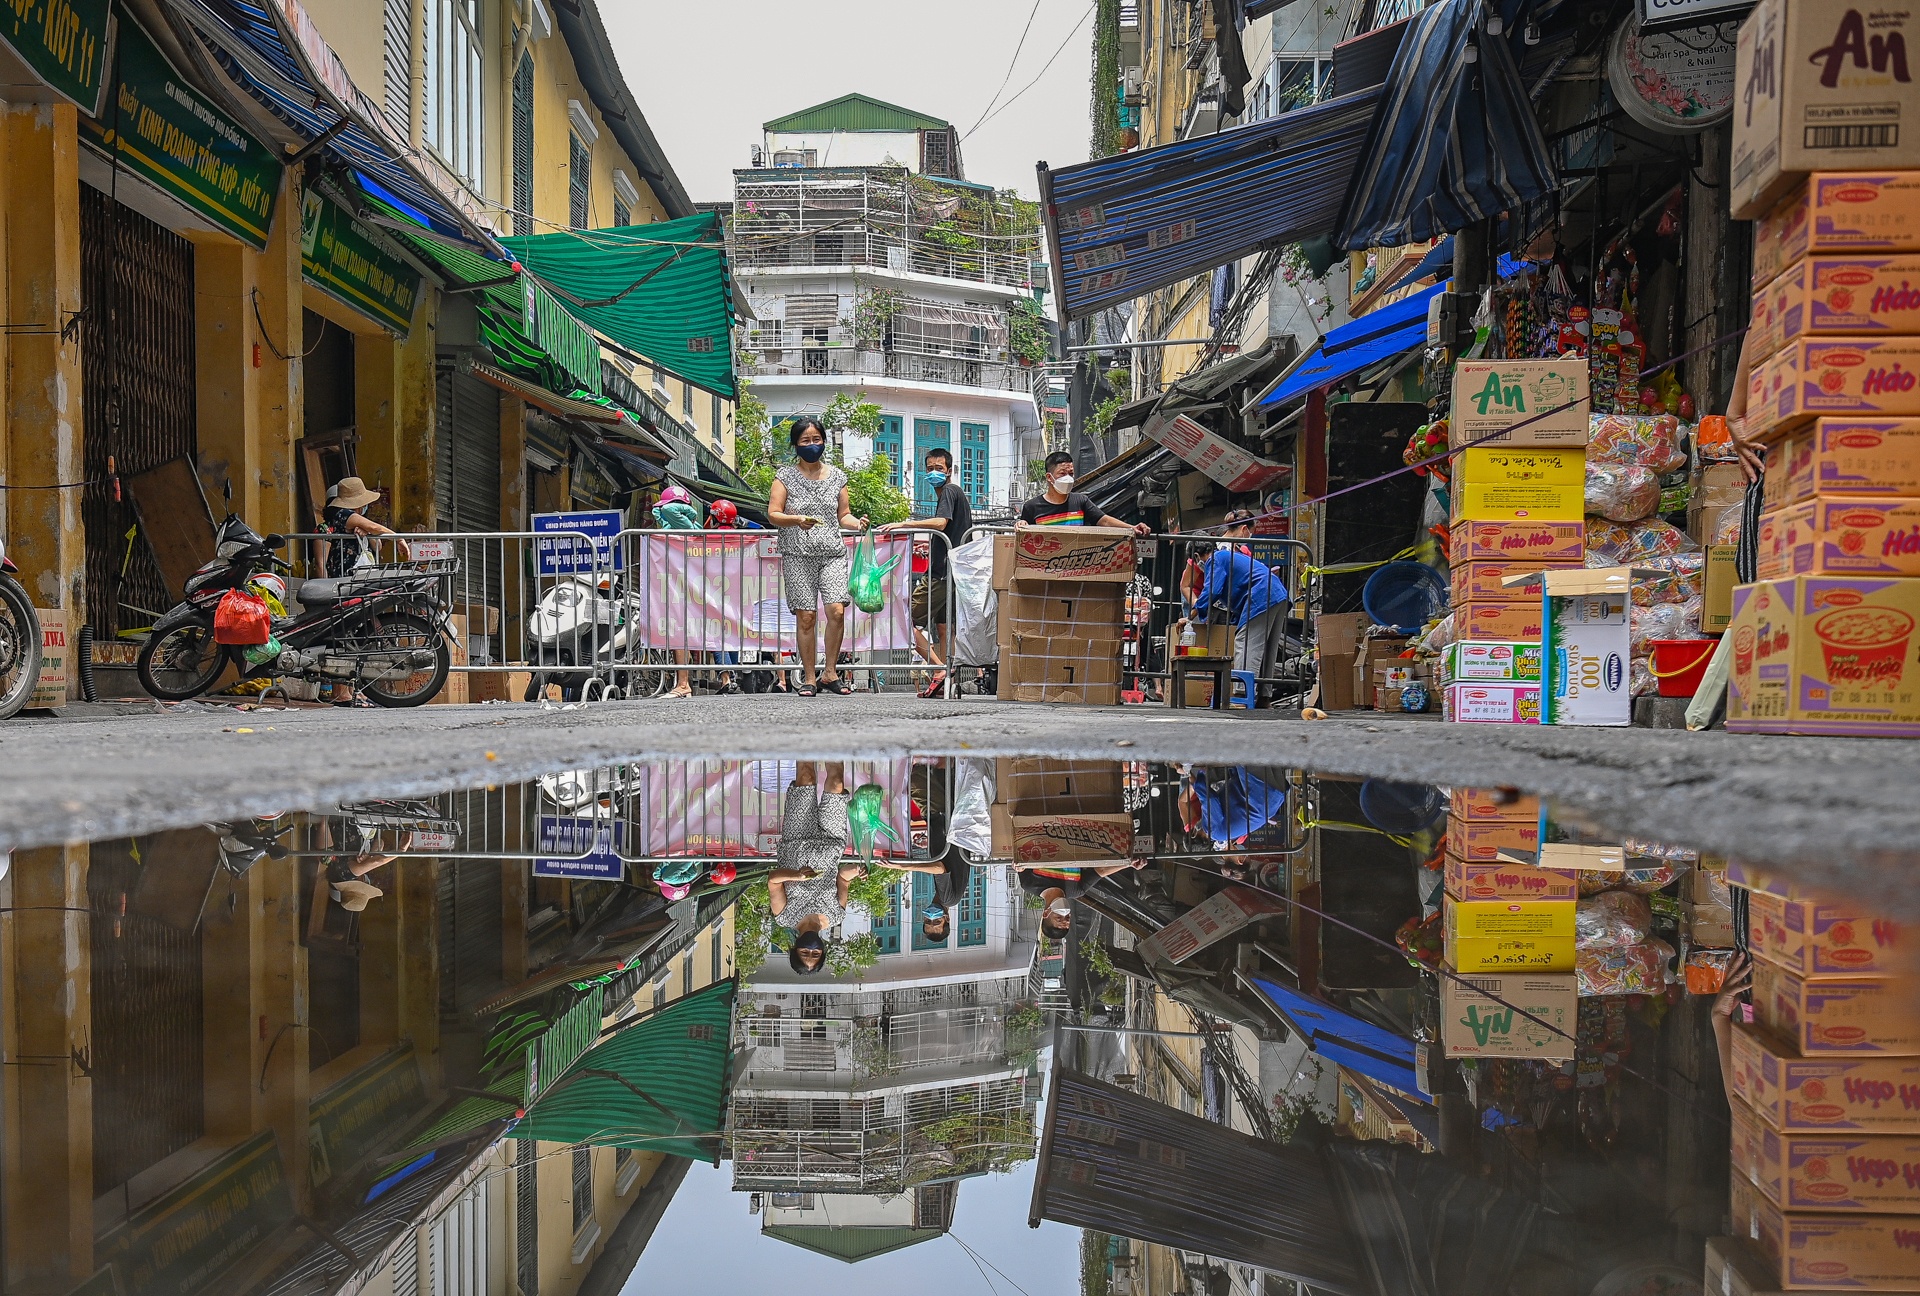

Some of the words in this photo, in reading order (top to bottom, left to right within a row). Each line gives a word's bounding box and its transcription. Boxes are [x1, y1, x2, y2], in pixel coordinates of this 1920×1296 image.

[79, 27, 95, 88] 11
[1674, 49, 1690, 58] Spa
[1688, 59, 1695, 67] &
[1697, 56, 1716, 66] Nail
[174, 90, 194, 111] NHÁNH
[193, 101, 215, 130] THƯƠNG
[137, 104, 165, 147] KINH
[163, 122, 198, 169] DOANH
[196, 136, 220, 185] TỔNG
[218, 162, 238, 201] HỢP
[259, 190, 271, 219] 10
[1862, 362, 1916, 396] Hảo
[1471, 372, 1526, 415] An
[1488, 457, 1508, 466] Cua
[1511, 457, 1536, 468] Riêu
[1538, 457, 1563, 468] Bún
[560, 520, 579, 528] PHƯỜNG
[580, 520, 593, 528] HÀNG
[1500, 534, 1526, 550] Hảo
[1528, 530, 1554, 547] Hảo
[1882, 525, 1920, 557] Hả
[562, 554, 570, 566] VỤ
[1568, 644, 1578, 666] SỮA
[1610, 654, 1618, 690] VINAMILK
[1568, 669, 1578, 699] TƯƠI
[1867, 692, 1876, 702] 21
